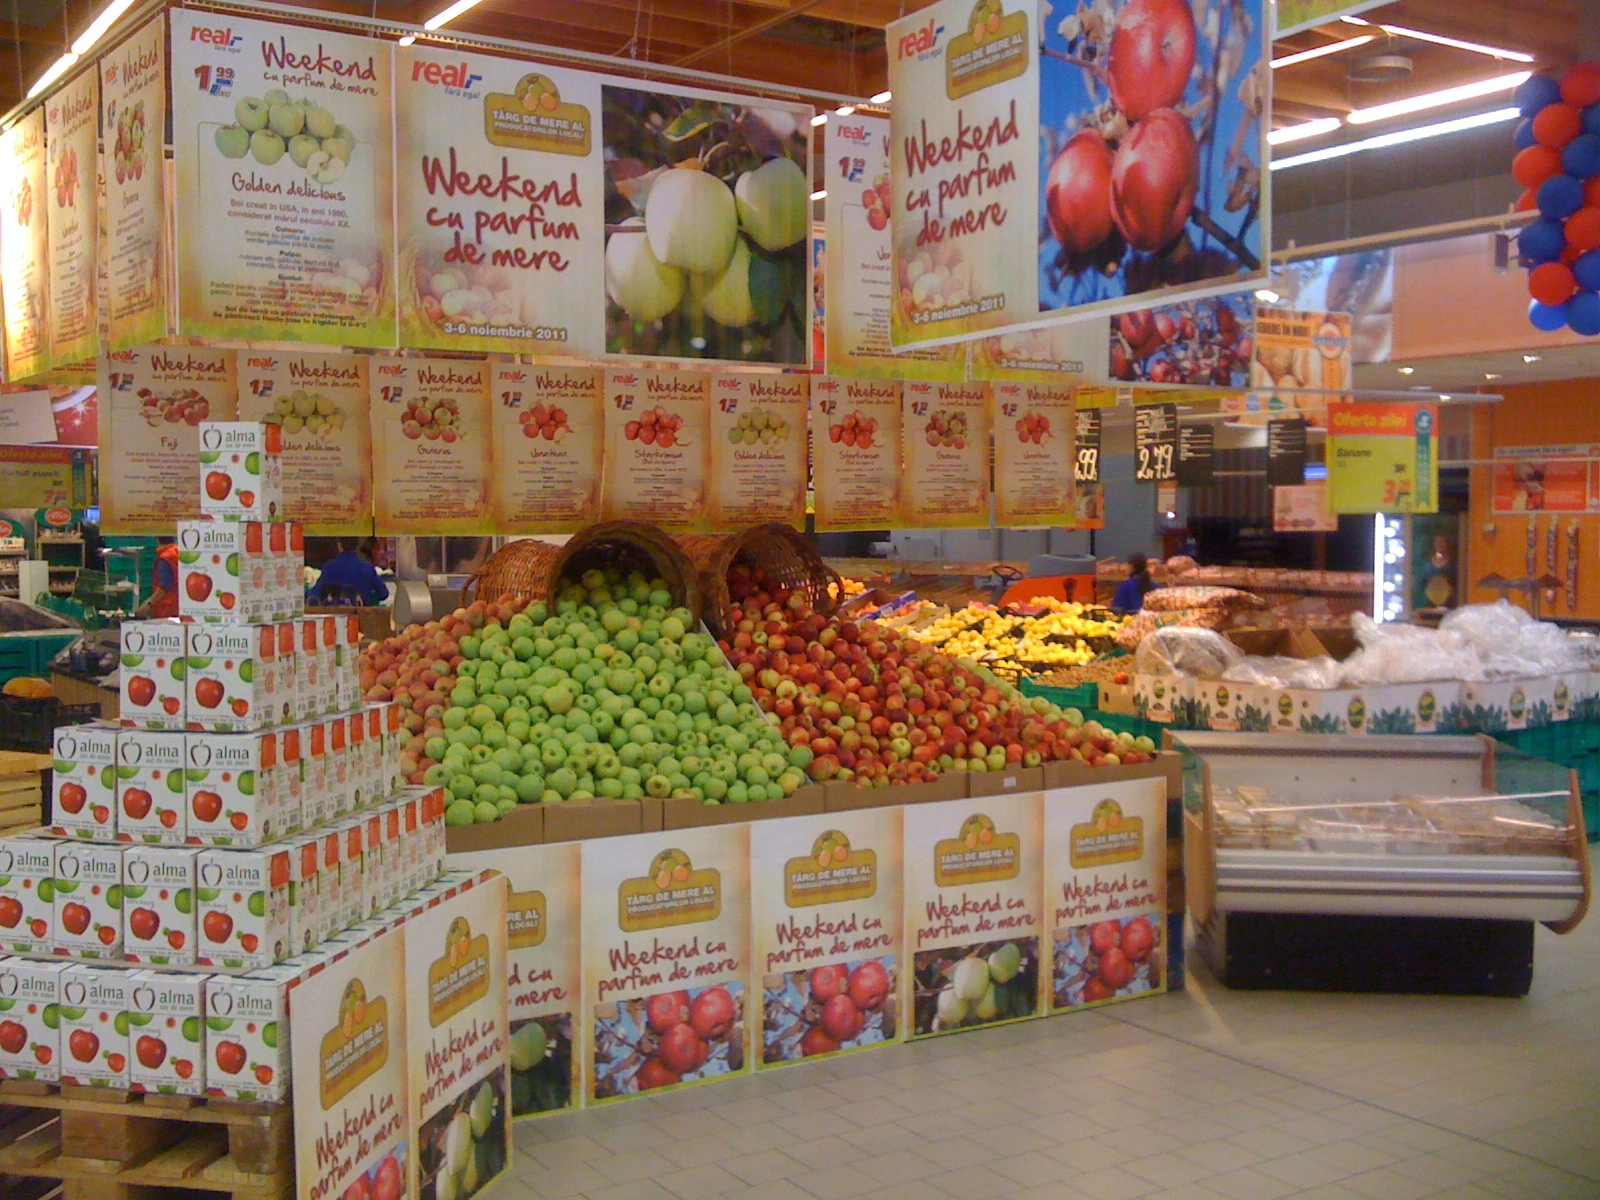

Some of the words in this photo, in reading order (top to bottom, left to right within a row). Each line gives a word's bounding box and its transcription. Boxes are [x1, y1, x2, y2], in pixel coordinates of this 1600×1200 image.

[262, 36, 376, 81] Weekend
[264, 72, 278, 82] cu
[282, 73, 326, 88] parfum
[330, 78, 345, 91] de
[348, 84, 378, 96] mere
[523, 115, 537, 124] DE
[540, 117, 569, 129] MERE
[572, 122, 585, 131] AL
[905, 99, 1018, 178] Weekend
[422, 146, 582, 207] Weekend
[906, 190, 931, 211] cu
[939, 152, 1016, 218] parfum
[232, 172, 282, 194] Golden
[287, 178, 346, 200] delicious
[426, 207, 464, 230] cu
[475, 204, 580, 244] parfum
[916, 210, 946, 246] de
[950, 202, 1008, 238] mere
[444, 231, 486, 265] de
[492, 247, 569, 272] mere
[913, 310, 929, 324] 3-6
[933, 302, 979, 320] noiembrie
[980, 295, 1005, 312] 2011
[444, 323, 466, 334] 3-6
[470, 326, 532, 338] noiembrie
[536, 328, 567, 340] 2011
[151, 351, 226, 373] Weekend
[289, 359, 360, 380] Weekend
[417, 365, 482, 384] Weekend
[536, 371, 595, 390] Weekend
[647, 376, 703, 393] Weekend
[750, 380, 802, 396] Weekend
[848, 381, 895, 398] Weekend
[939, 384, 984, 400] Weekend
[161, 436, 178, 450] Fuji
[226, 430, 255, 443] alma
[204, 530, 234, 543] alma
[148, 632, 180, 647] alma
[216, 634, 248, 648] alma
[80, 739, 110, 754] alma
[146, 744, 179, 758] alma
[216, 746, 249, 760] alma
[17, 852, 49, 866] alma
[965, 851, 977, 861] DE
[979, 850, 1003, 861] MERE
[1005, 848, 1015, 857] AL
[83, 858, 116, 874] alma
[153, 862, 186, 877] alma
[227, 865, 260, 880] alma
[818, 870, 831, 879] DE
[833, 868, 858, 878] MERE
[861, 865, 871, 875] AL
[656, 892, 670, 902] DE
[672, 888, 700, 899] MERE
[703, 885, 715, 895] AL
[1063, 873, 1128, 901] Weekend
[1133, 878, 1148, 890] cu
[526, 909, 539, 920] AL
[926, 892, 1002, 922] Weekend
[1007, 898, 1026, 909] cu
[1056, 900, 1100, 925] parfum
[1106, 896, 1124, 913] de
[1125, 894, 1156, 908] mere
[510, 920, 538, 930] LOCALI
[776, 912, 858, 945] Weekend
[863, 918, 883, 929] cu
[917, 919, 970, 948] parfum
[975, 915, 998, 933] de
[1000, 914, 1036, 930] mere
[609, 936, 699, 972] Weekend
[706, 942, 726, 953] cu
[768, 940, 825, 973] parfum
[830, 936, 851, 955] de
[854, 934, 893, 950] mere
[529, 966, 553, 982] cu
[598, 967, 664, 1001] parfum
[668, 962, 693, 982] de
[695, 957, 739, 977] mere
[22, 976, 55, 992] alma
[90, 984, 124, 999] alma
[160, 990, 194, 1005] alma
[237, 995, 272, 1009] alma
[515, 986, 568, 1007] mere
[425, 1019, 478, 1080] Weekend
[482, 1020, 495, 1036] cu
[420, 1068, 456, 1119] parfum
[460, 1053, 474, 1078] de
[476, 1038, 503, 1065] mere
[316, 1093, 377, 1170] Weekend
[380, 1093, 394, 1114] cu
[356, 1134, 370, 1165] de
[373, 1112, 403, 1147] mere
